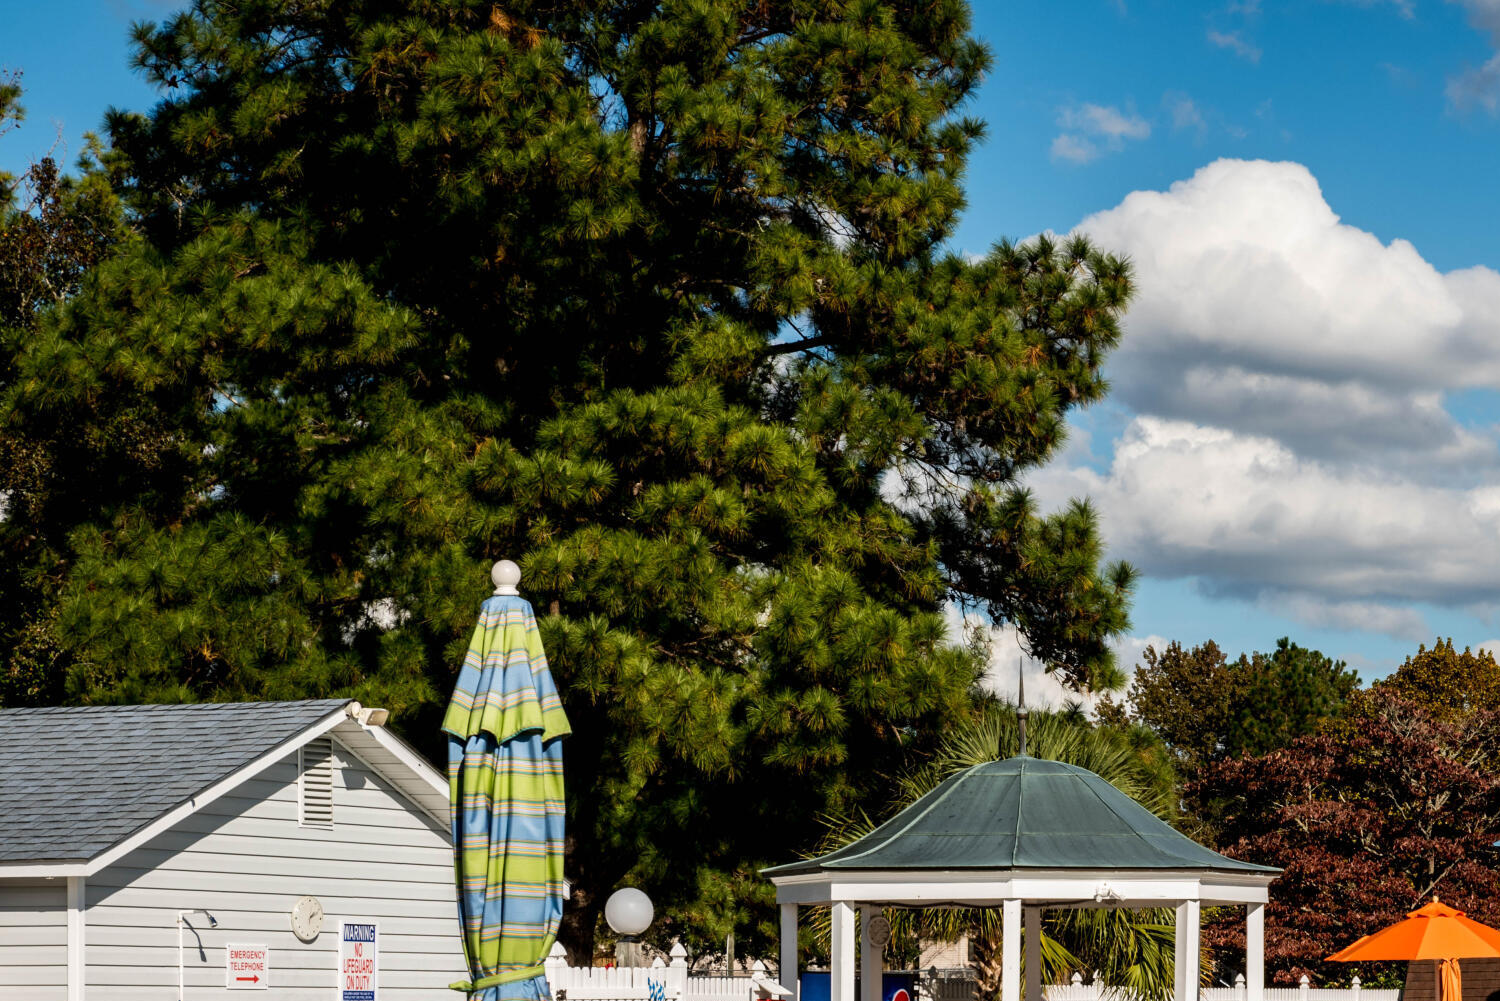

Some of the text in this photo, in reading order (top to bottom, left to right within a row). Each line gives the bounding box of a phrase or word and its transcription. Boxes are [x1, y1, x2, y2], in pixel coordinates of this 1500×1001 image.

[344, 925, 375, 941] WARNING
[230, 950, 266, 960] EMERGENCY
[354, 942, 363, 958] NO
[230, 961, 264, 971] TELEPHONE
[343, 958, 374, 974] LIFEGUARD
[346, 975, 370, 990] ON DUTY
